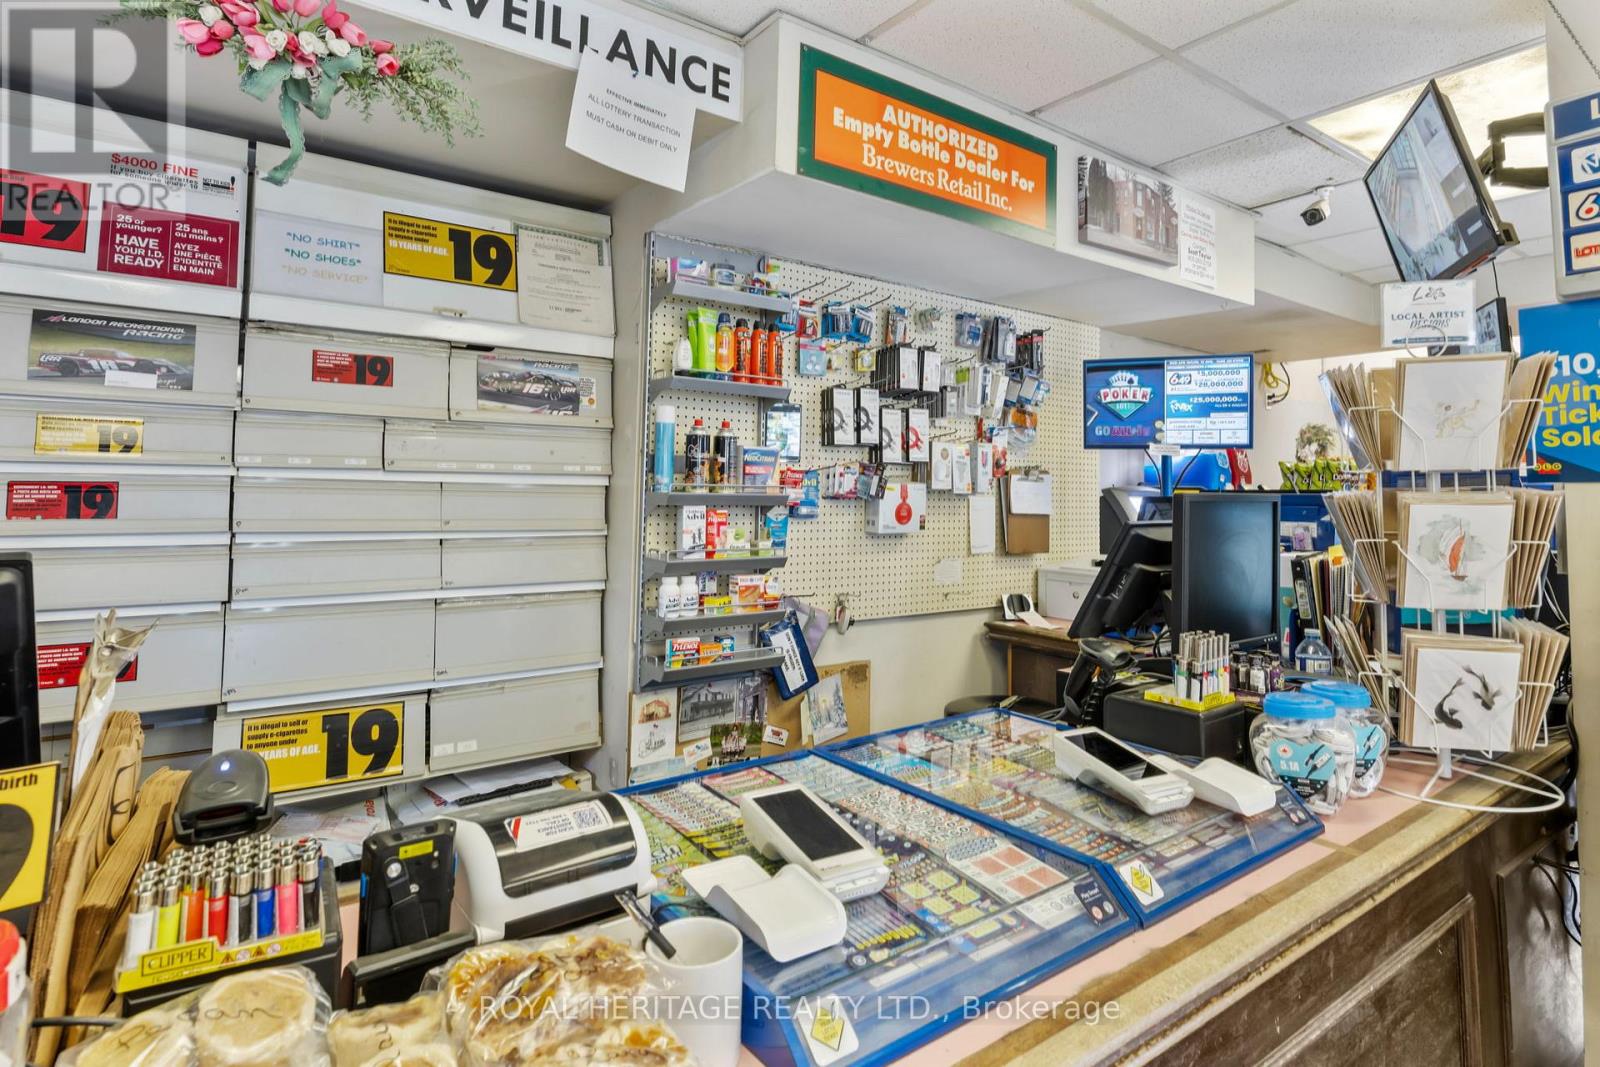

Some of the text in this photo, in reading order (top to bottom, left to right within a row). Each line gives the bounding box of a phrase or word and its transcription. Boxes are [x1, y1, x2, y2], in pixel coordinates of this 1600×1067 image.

[606, 88, 667, 118] EFFECTIVE IMMEDIATELY
[588, 93, 681, 137] ALL LOTTERY TRANSACTION
[586, 110, 677, 153] MUST CASH OR DEBIT ONLY
[883, 104, 998, 161] AUTHORIZED
[833, 106, 1034, 193] Empty Bottle Dealer For
[112, 153, 198, 177] $4000 FINE
[862, 143, 1013, 212] Brewers Retail Inc.
[117, 214, 132, 222] 25
[116, 222, 162, 233] younger?
[176, 223, 190, 232] 25
[115, 234, 159, 249] HAVE
[174, 242, 200, 252] AYEZ
[115, 245, 164, 258] YOUR I.D.
[195, 252, 221, 261] PIÈCE
[448, 227, 513, 286] 19
[114, 254, 164, 268] READY
[189, 267, 214, 275] MAIN
[1391, 311, 1465, 321] LOCAL ARTIST
[353, 354, 390, 386] 19
[522, 383, 545, 393] 16
[1103, 389, 1148, 401] POKER
[1095, 425, 1110, 436] GO
[97, 424, 138, 452] 19
[64, 485, 115, 519] 19
[686, 511, 705, 520] Advil
[260, 722, 281, 730] illegal
[270, 728, 308, 737] e-cigarettes
[254, 740, 278, 749] anyone
[322, 708, 399, 779] 19
[290, 746, 301, 757] OF
[147, 948, 208, 970] CLIPPER
